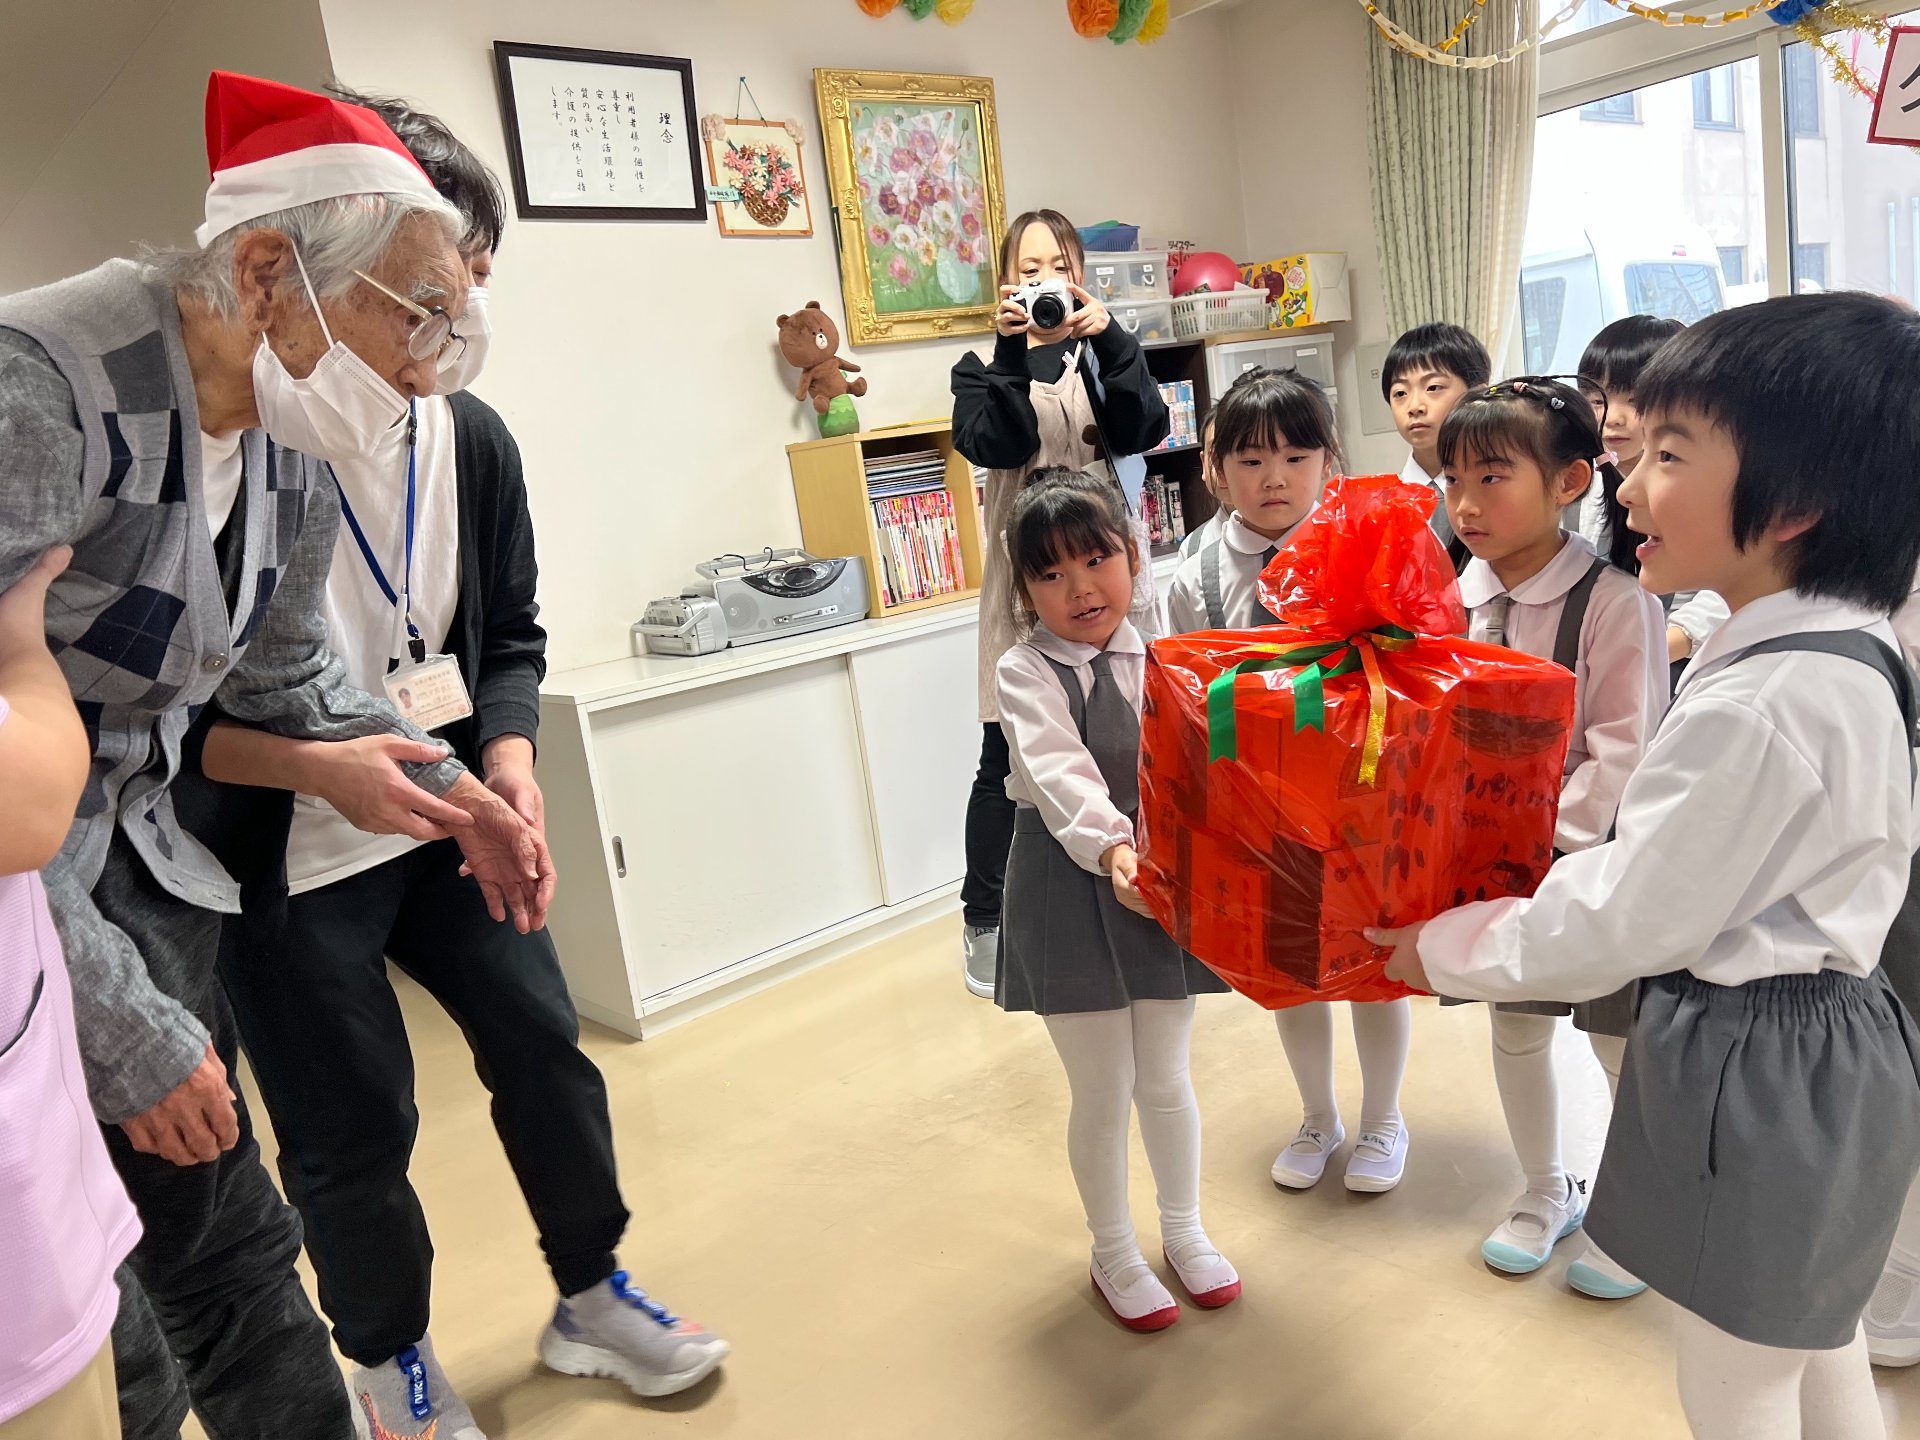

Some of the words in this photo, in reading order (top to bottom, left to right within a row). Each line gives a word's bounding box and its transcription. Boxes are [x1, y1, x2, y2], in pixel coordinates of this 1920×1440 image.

[565, 87, 586, 192] 介護の提供を目指
[581, 88, 594, 133] 質の高い
[596, 89, 615, 192] 安心な生活環境と
[611, 89, 621, 125] 尊重し
[626, 91, 644, 192] 利用者様の個性を
[659, 112, 673, 144] 理念
